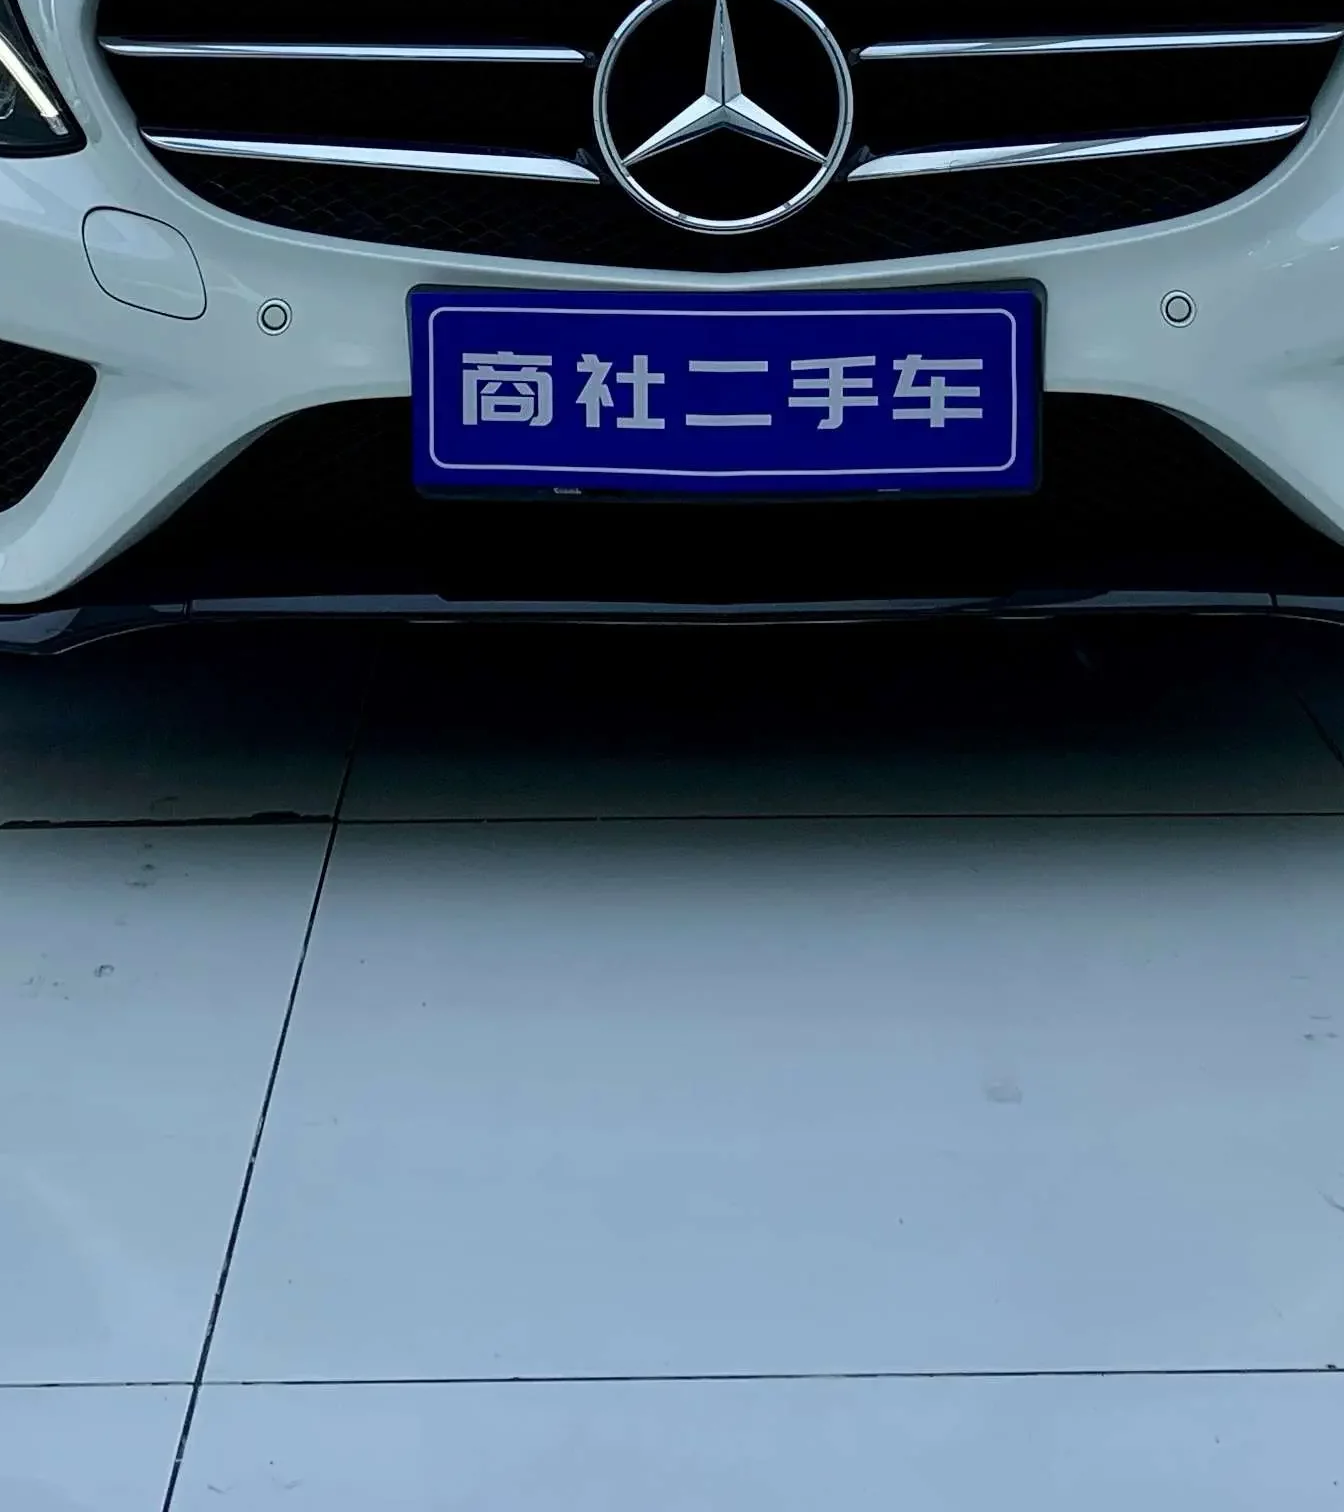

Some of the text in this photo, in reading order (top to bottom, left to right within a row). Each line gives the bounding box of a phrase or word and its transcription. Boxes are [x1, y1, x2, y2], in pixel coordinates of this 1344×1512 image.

[461, 350, 984, 430] 商社二手车
